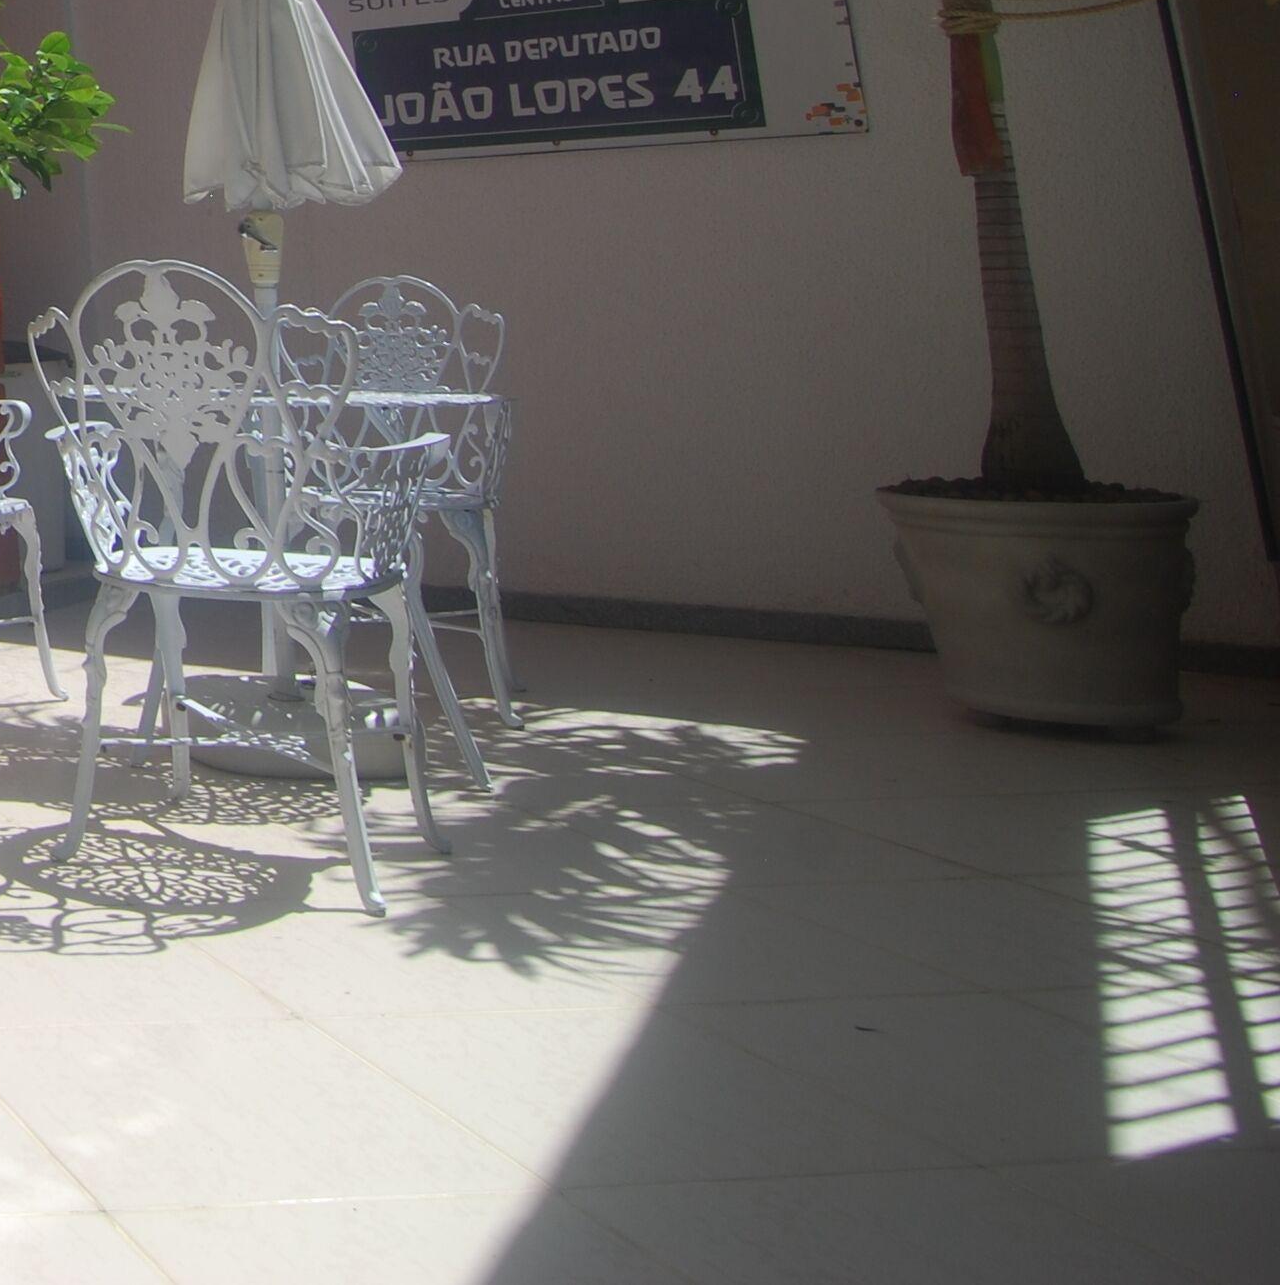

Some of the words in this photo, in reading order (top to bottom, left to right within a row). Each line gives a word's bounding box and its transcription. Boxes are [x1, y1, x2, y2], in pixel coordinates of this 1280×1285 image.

[432, 42, 496, 70] RUA
[503, 25, 662, 64] DEPUTADO
[380, 81, 495, 128] JOÃO
[508, 71, 655, 117] LOPES
[673, 64, 742, 104] 44
